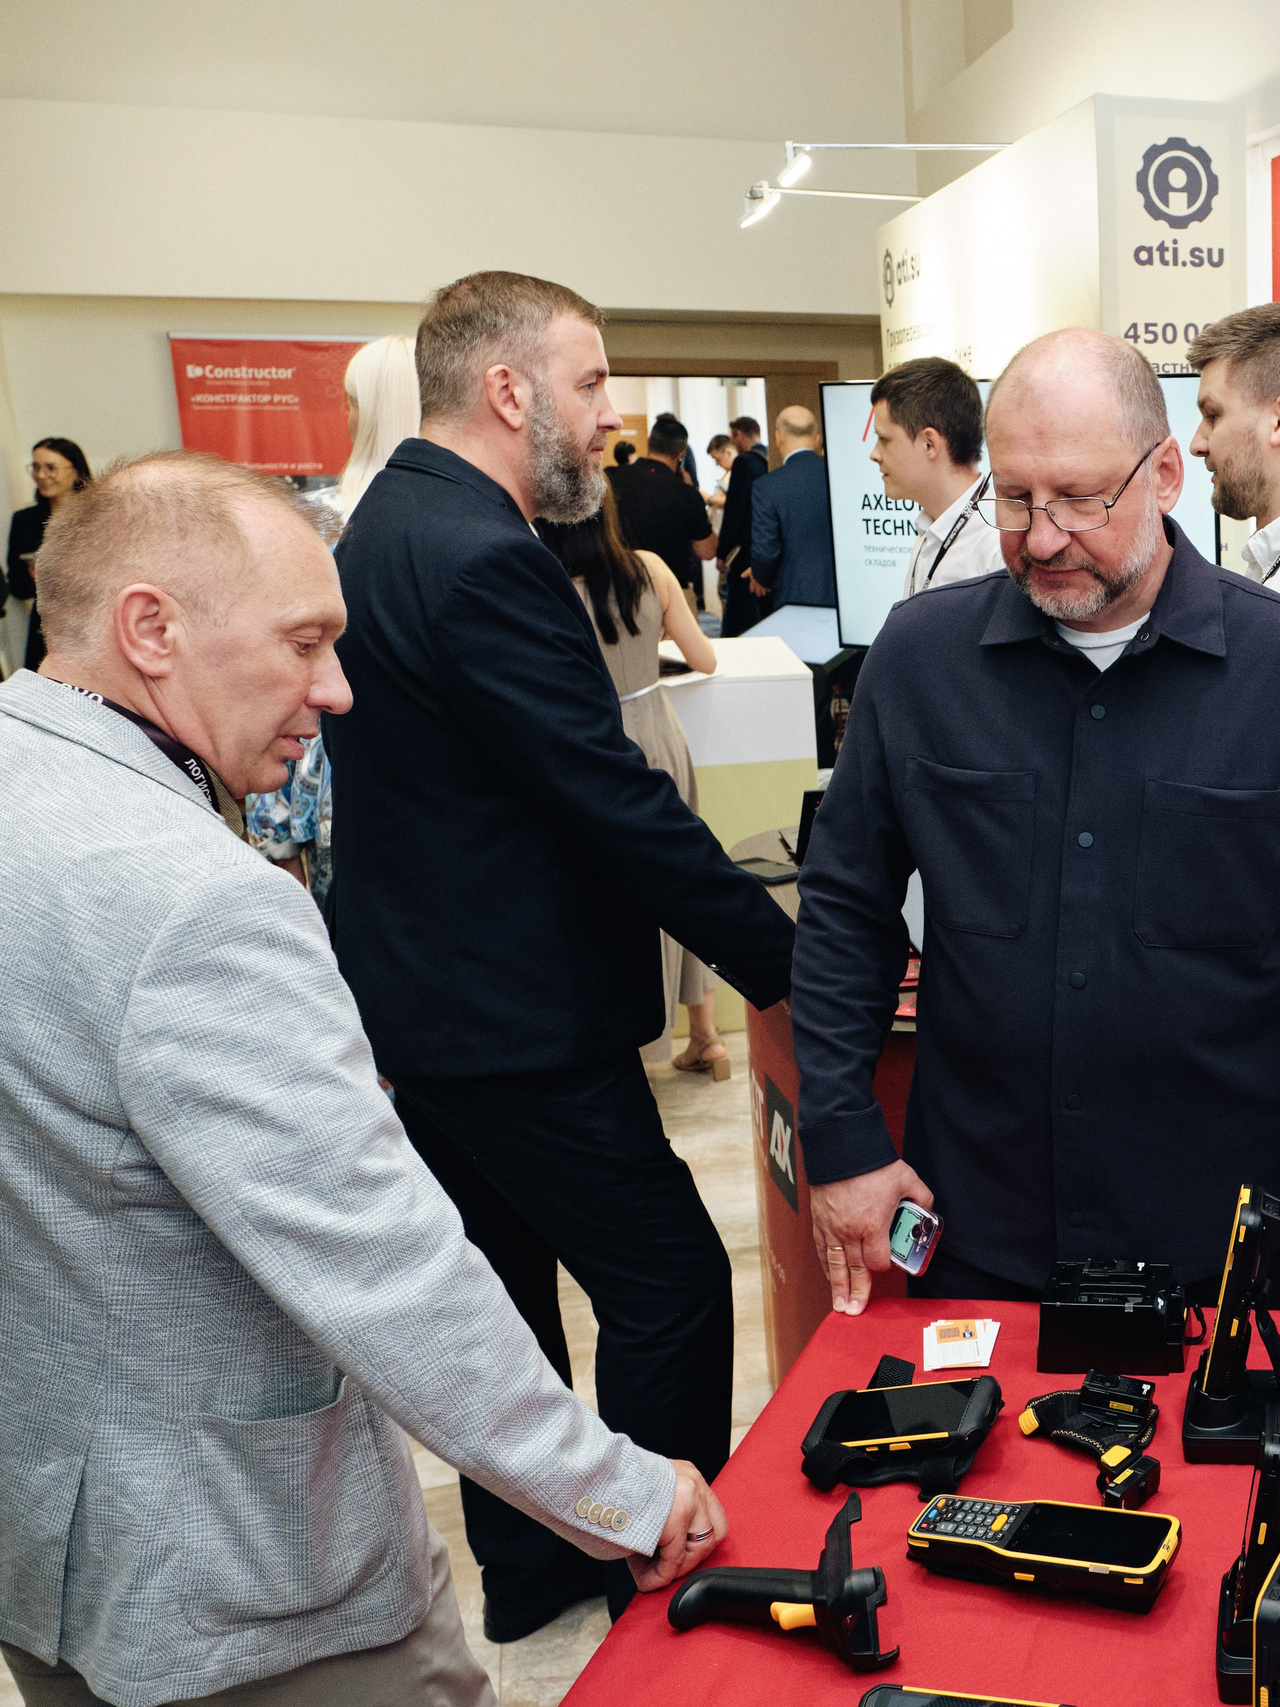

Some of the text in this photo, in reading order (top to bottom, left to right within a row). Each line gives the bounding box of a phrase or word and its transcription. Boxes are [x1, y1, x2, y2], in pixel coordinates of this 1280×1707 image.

[1133, 239, 1225, 268] ati.su
[1124, 322, 1178, 344] 450
[205, 364, 293, 379] Constructor
[861, 494, 922, 511] AXELO
